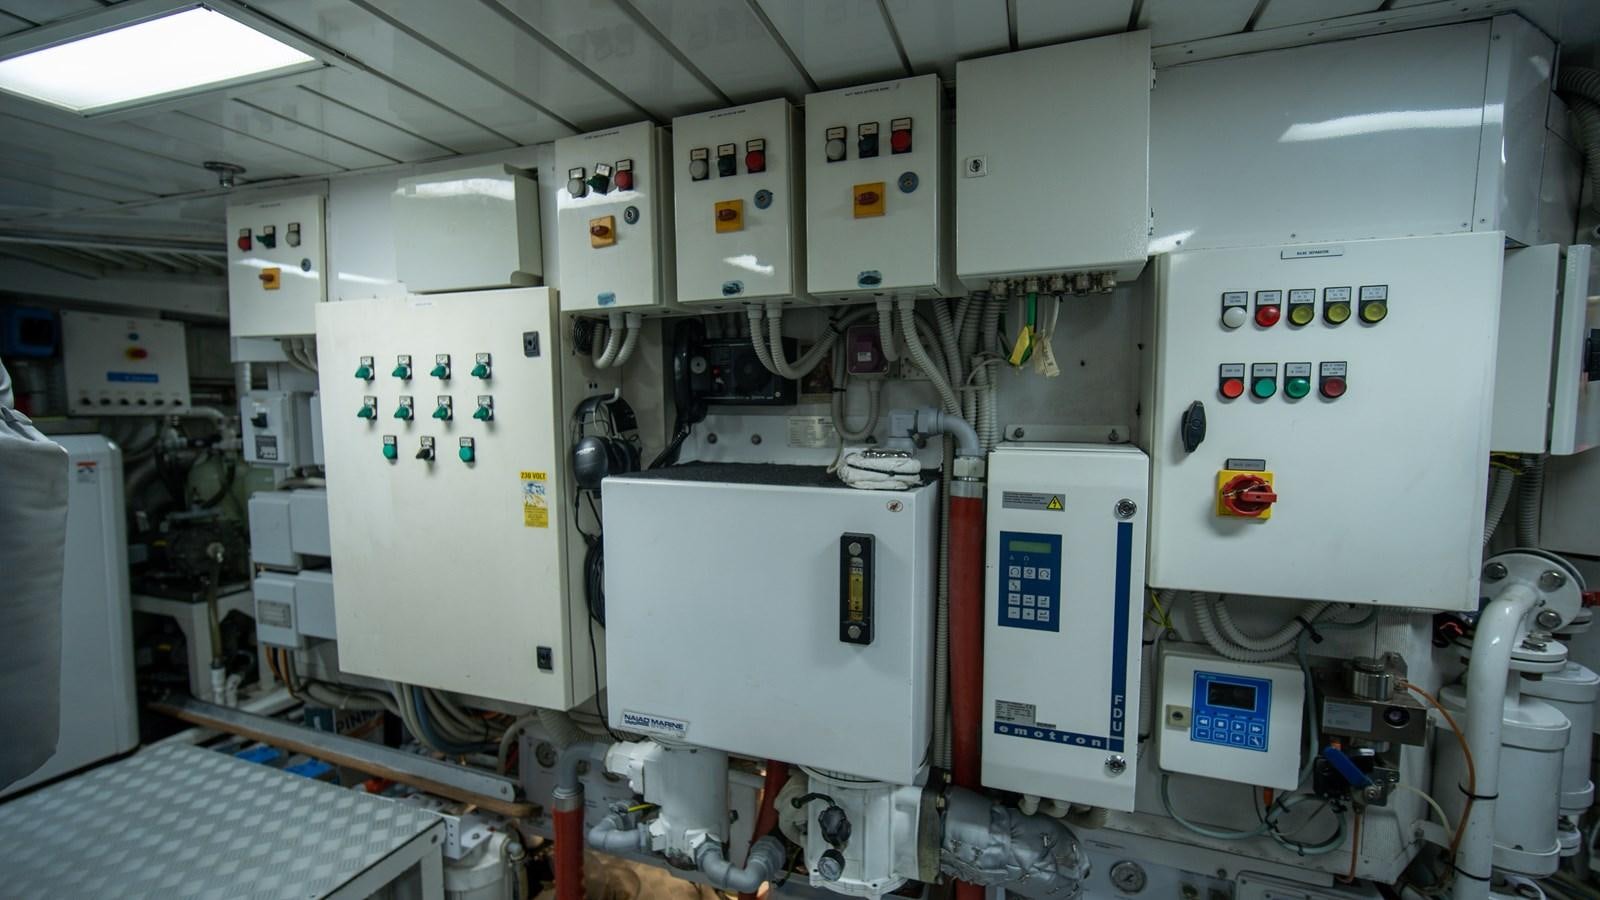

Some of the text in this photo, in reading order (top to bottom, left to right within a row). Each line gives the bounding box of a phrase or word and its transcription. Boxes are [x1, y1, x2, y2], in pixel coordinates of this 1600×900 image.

[520, 471, 531, 479] 230
[624, 714, 650, 724] NAIAD
[651, 719, 684, 730] MARINE
[1112, 695, 1123, 732] FDU
[998, 725, 1102, 747] emotron
